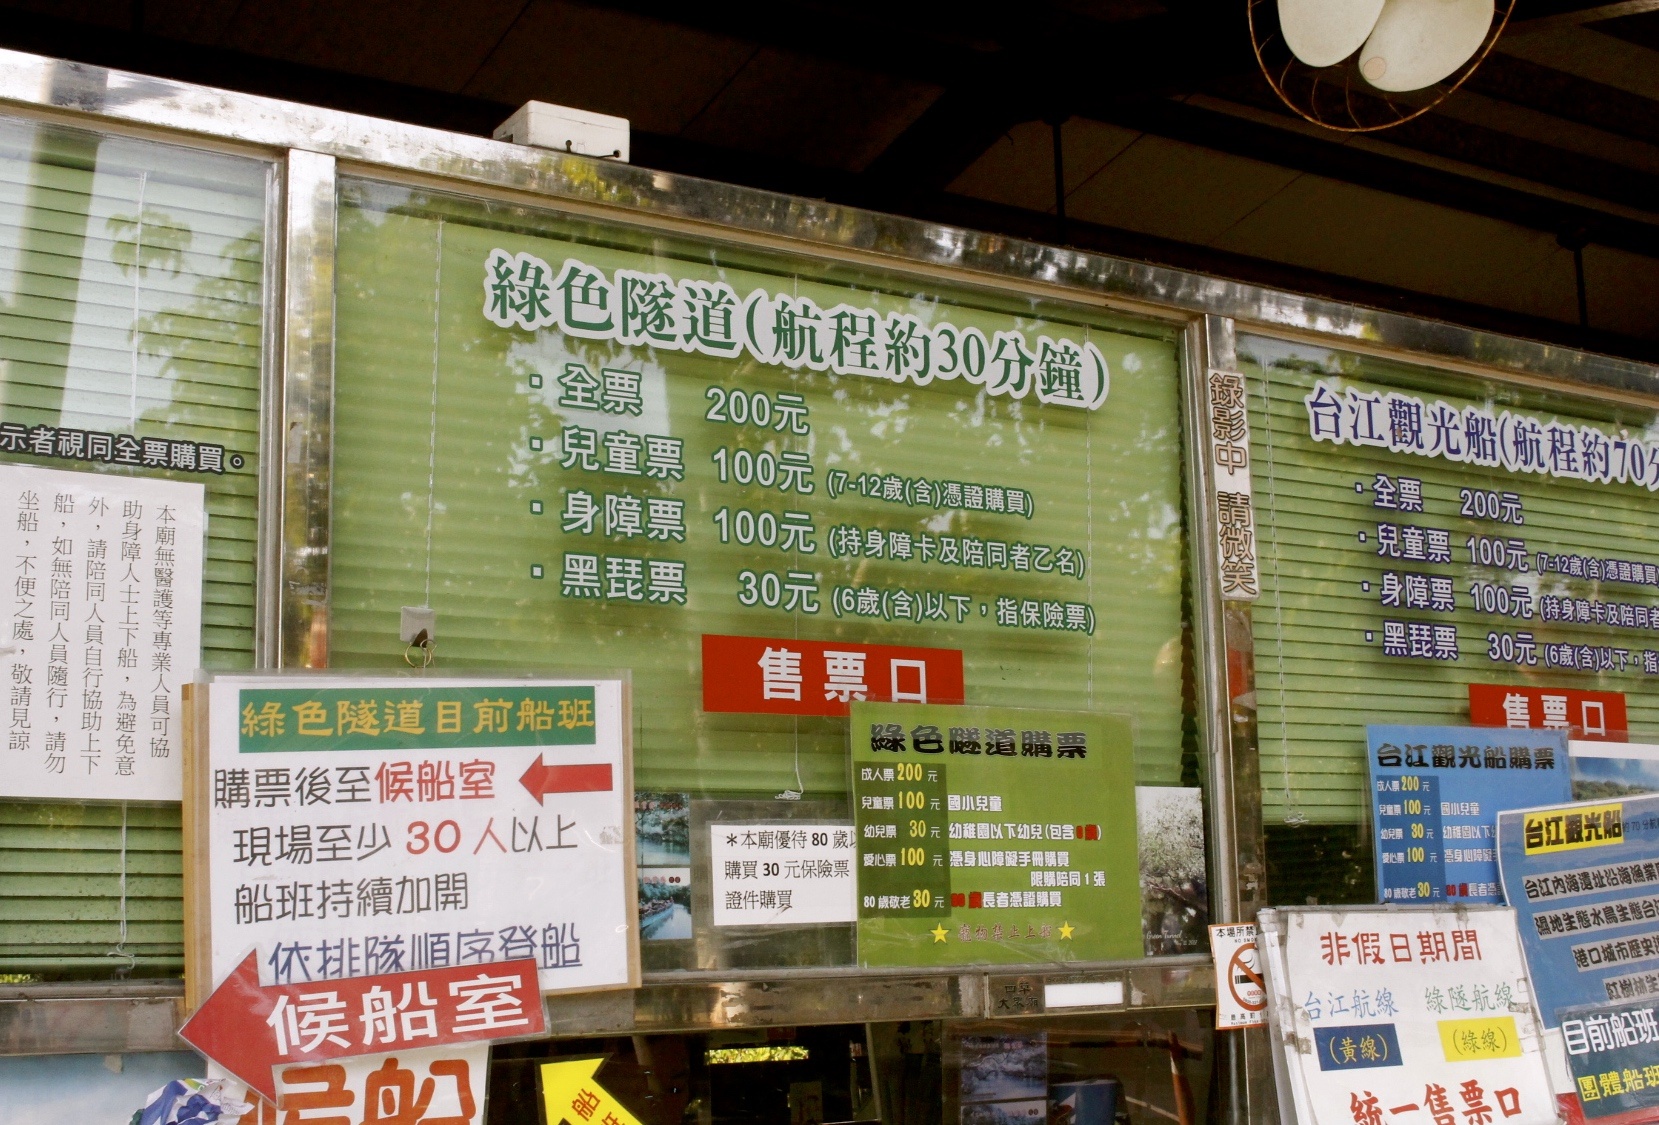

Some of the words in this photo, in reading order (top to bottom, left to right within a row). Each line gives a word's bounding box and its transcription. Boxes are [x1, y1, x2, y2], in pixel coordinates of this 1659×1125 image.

[491, 255, 1109, 404] 綠色隧道(航程約30分鐘)
[559, 365, 642, 415] 全票
[706, 388, 811, 436] 200元
[1209, 373, 1247, 475] 錄影中
[561, 428, 685, 481] 兒童票
[712, 448, 815, 495] 100元
[828, 470, 1034, 518] (7-12歲(含)憑證購買)
[1373, 474, 1423, 513] 全票
[1460, 490, 1524, 525] 200元
[562, 492, 686, 542] 身障票
[714, 509, 815, 555] 100元
[828, 526, 1085, 579] (持身障卡及陪同者乙名)
[1217, 492, 1257, 595] 請微笑
[1377, 524, 1450, 564] 兒童票
[1467, 536, 1528, 573] 100元
[562, 553, 687, 604] 黑琵票
[738, 570, 820, 616] 30元
[832, 587, 1096, 634] (6歲(含)以下，指保險票)
[1381, 573, 1455, 612] 身障票
[1471, 584, 1534, 620] 100元
[149, 505, 177, 759] 本廟無醫護等專業人員可協
[1383, 622, 1459, 660] 黑琵票
[1488, 633, 1537, 666] 30元
[1544, 643, 1659, 675] (6歲(含)以下，指
[757, 647, 928, 703] 售票口
[241, 697, 596, 738] 綠色隧道目前船班
[1502, 693, 1606, 736] 售票口
[869, 722, 1088, 759] 綠色隧道購票
[1378, 744, 1555, 769] 台江觀光船購票
[214, 759, 496, 809] 購票後至候船室
[861, 767, 895, 782] 成人票
[897, 763, 923, 781] 200
[927, 770, 938, 783] 元
[1401, 776, 1419, 791] 200
[861, 795, 894, 810] 兒童票
[898, 791, 925, 810] 100
[930, 798, 940, 811] 元
[947, 795, 1003, 812] 國小兒童
[1404, 800, 1421, 815] 100
[233, 822, 393, 867] 現場至少
[405, 819, 462, 855] 30
[473, 813, 578, 856] 人以上
[811, 833, 829, 847] 80
[909, 820, 927, 838] 30
[930, 826, 940, 839] 元
[1411, 823, 1424, 839] 30
[724, 860, 758, 880] 購買
[763, 862, 780, 877] 30
[784, 859, 850, 879] 元保險票
[900, 847, 925, 866] 100
[933, 854, 943, 867] 元
[1407, 847, 1424, 862] 100
[234, 872, 469, 925] 船班持續加開
[724, 889, 793, 911] 證件購買
[863, 896, 876, 908] 80
[913, 889, 931, 908] 30
[934, 896, 944, 909] 元
[1417, 882, 1430, 897] 30
[268, 922, 583, 984] 依排隊順序登船
[1320, 930, 1482, 965] 非假日期間
[1304, 987, 1400, 1021] 台江航線
[1424, 981, 1517, 1014] 綠隧航線
[1605, 973, 1659, 1000] 紅樹林生
[266, 973, 529, 1055] 候船室
[1562, 1008, 1659, 1055] 目前船班
[1330, 1034, 1388, 1064] (黃線)
[1453, 1027, 1507, 1056] (綠線)
[1350, 1079, 1522, 1125] 統一售票口
